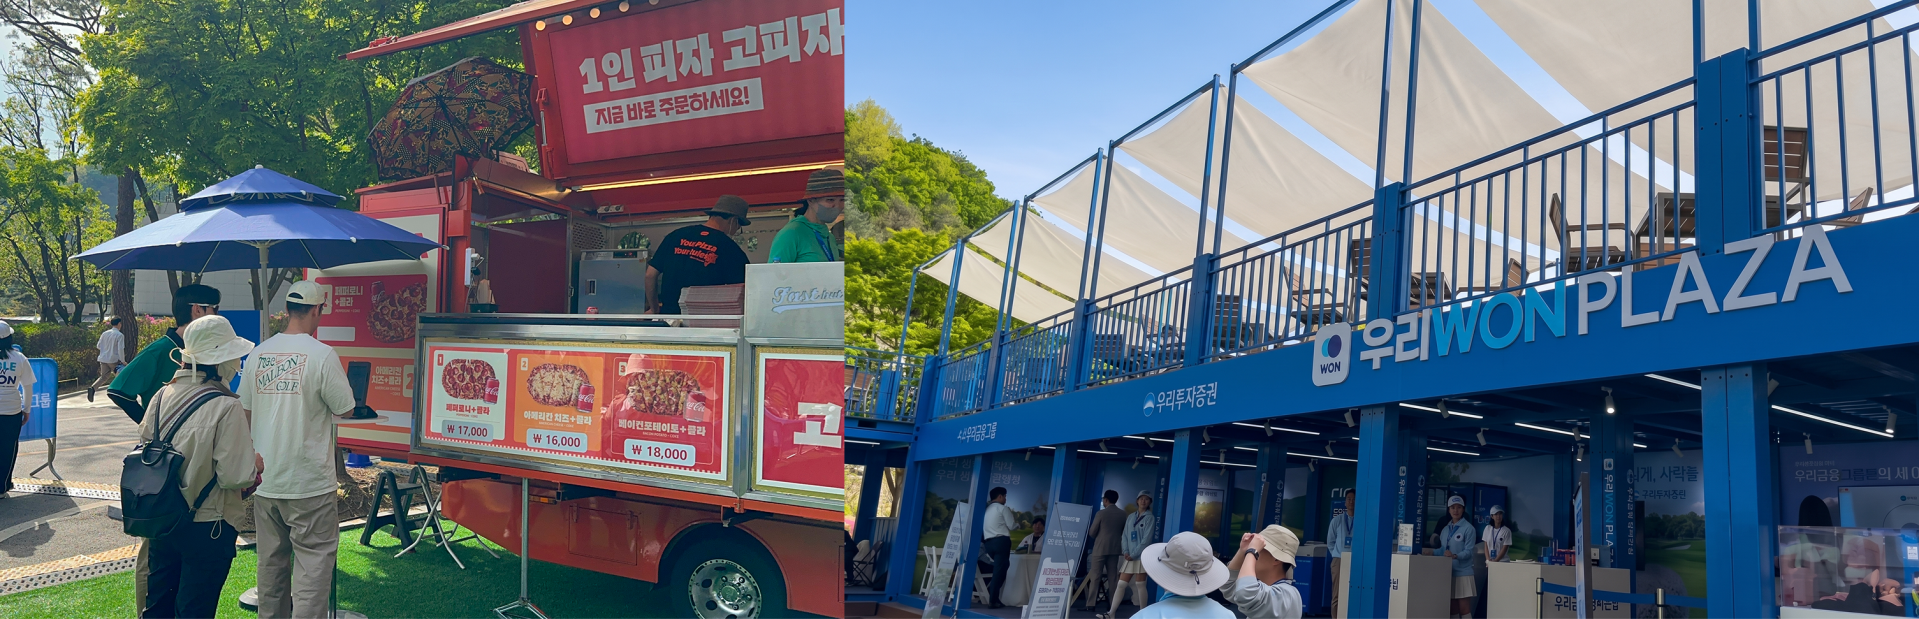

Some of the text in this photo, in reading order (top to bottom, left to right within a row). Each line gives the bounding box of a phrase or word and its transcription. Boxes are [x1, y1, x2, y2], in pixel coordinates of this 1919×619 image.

[579, 7, 845, 94] 1인 피자 고피자
[594, 85, 751, 126] 지금 바로 주문하세요!
[521, 360, 527, 368] 2
[620, 364, 626, 373] 3
[1320, 361, 1341, 375] WON
[1156, 382, 1218, 413] 우리투자증권
[458, 425, 488, 438] 17,000
[793, 401, 844, 449] 고
[546, 434, 581, 448] 16,000
[647, 445, 688, 461] 18,000
